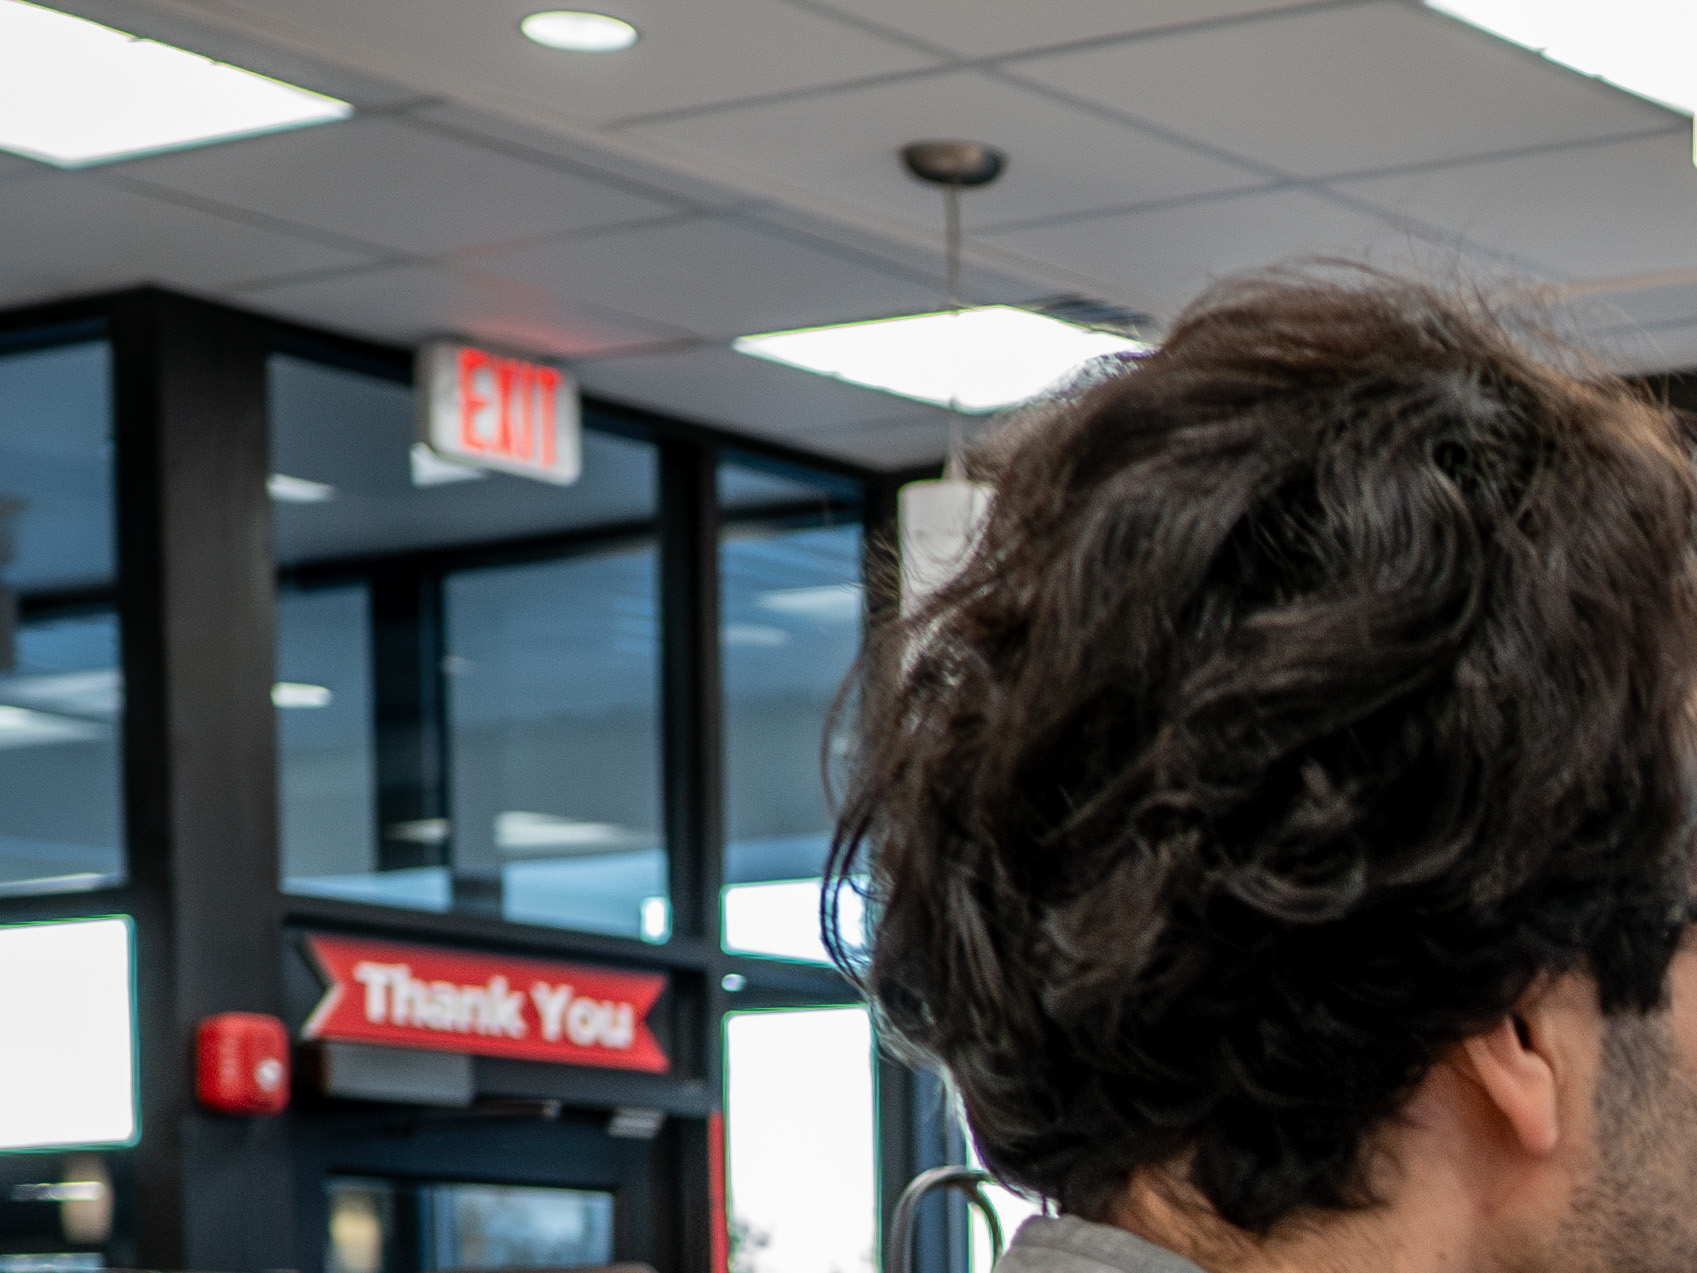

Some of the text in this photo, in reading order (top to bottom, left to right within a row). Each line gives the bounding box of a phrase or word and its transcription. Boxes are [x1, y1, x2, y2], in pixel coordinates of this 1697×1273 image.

[457, 347, 561, 471] EXIT
[354, 960, 635, 1050] Thank You
